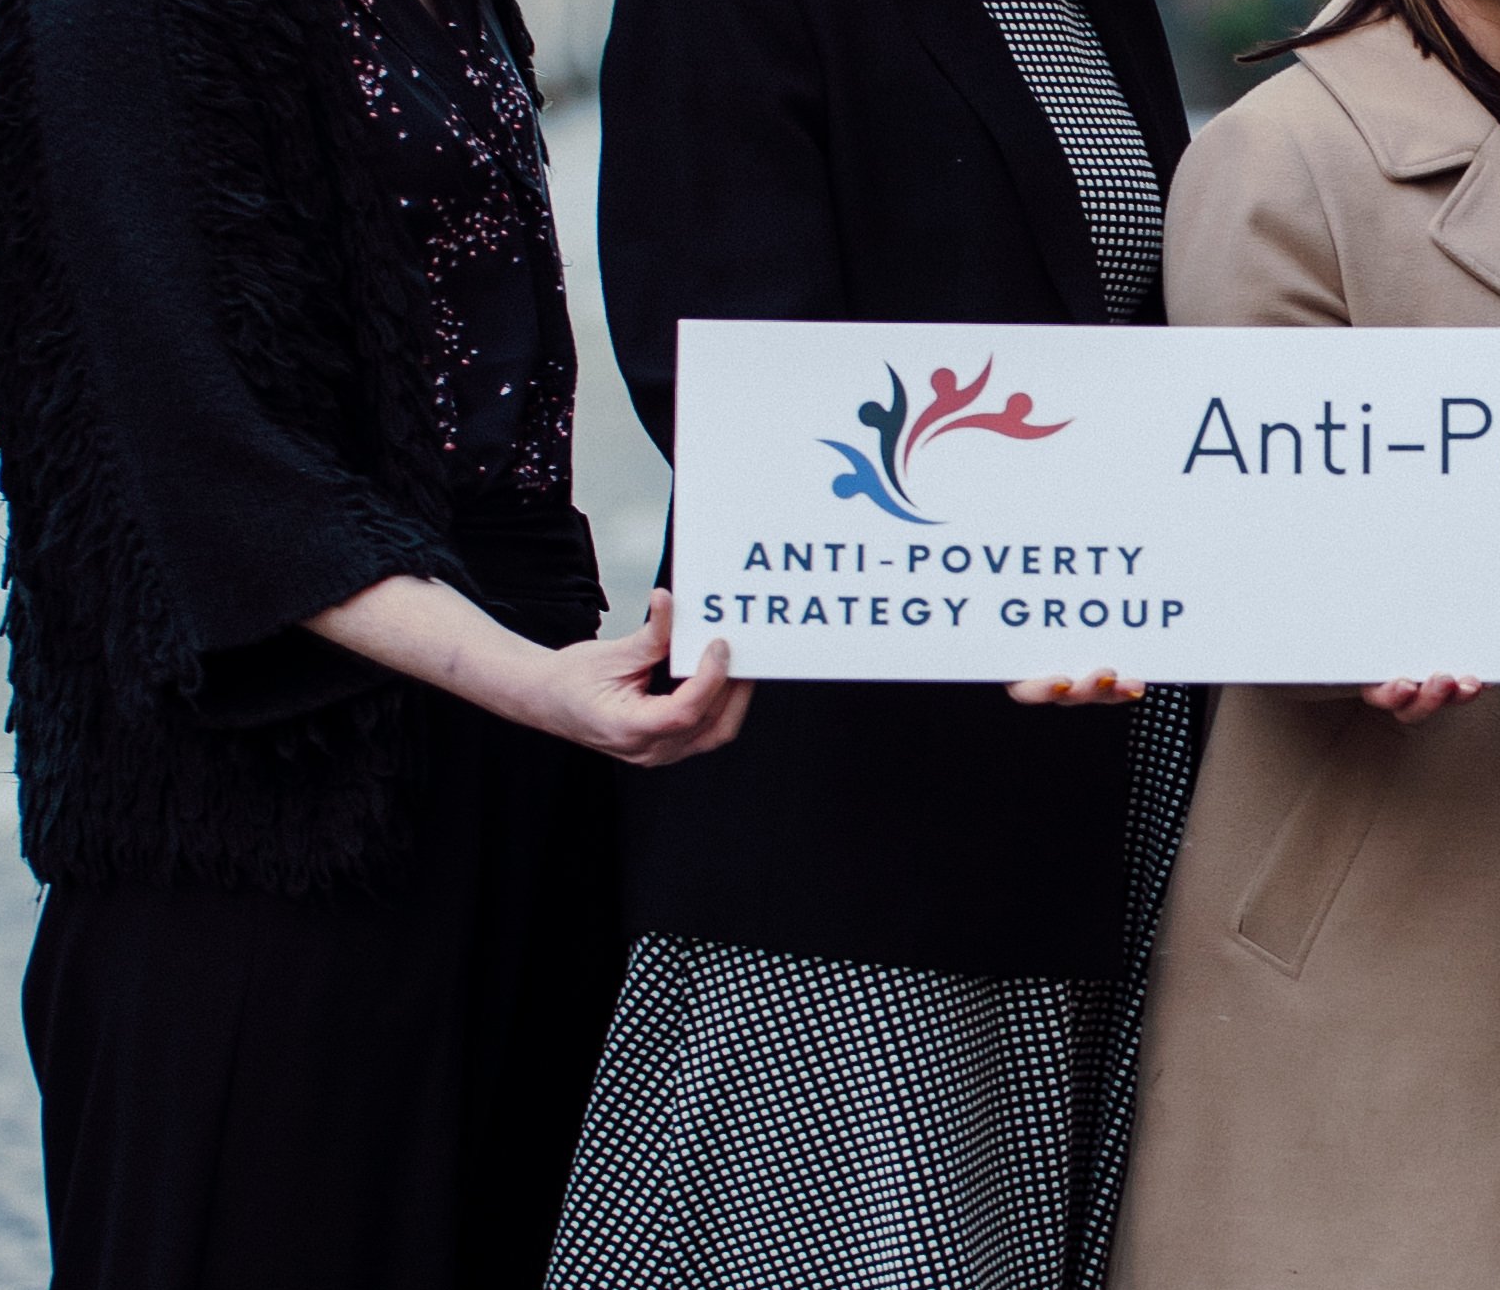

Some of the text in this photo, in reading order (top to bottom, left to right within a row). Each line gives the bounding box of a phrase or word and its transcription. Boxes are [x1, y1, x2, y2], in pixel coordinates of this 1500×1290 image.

[743, 541, 1144, 576] ANTI-POVERTY
[702, 593, 1185, 629] STRATEGY GROUP
